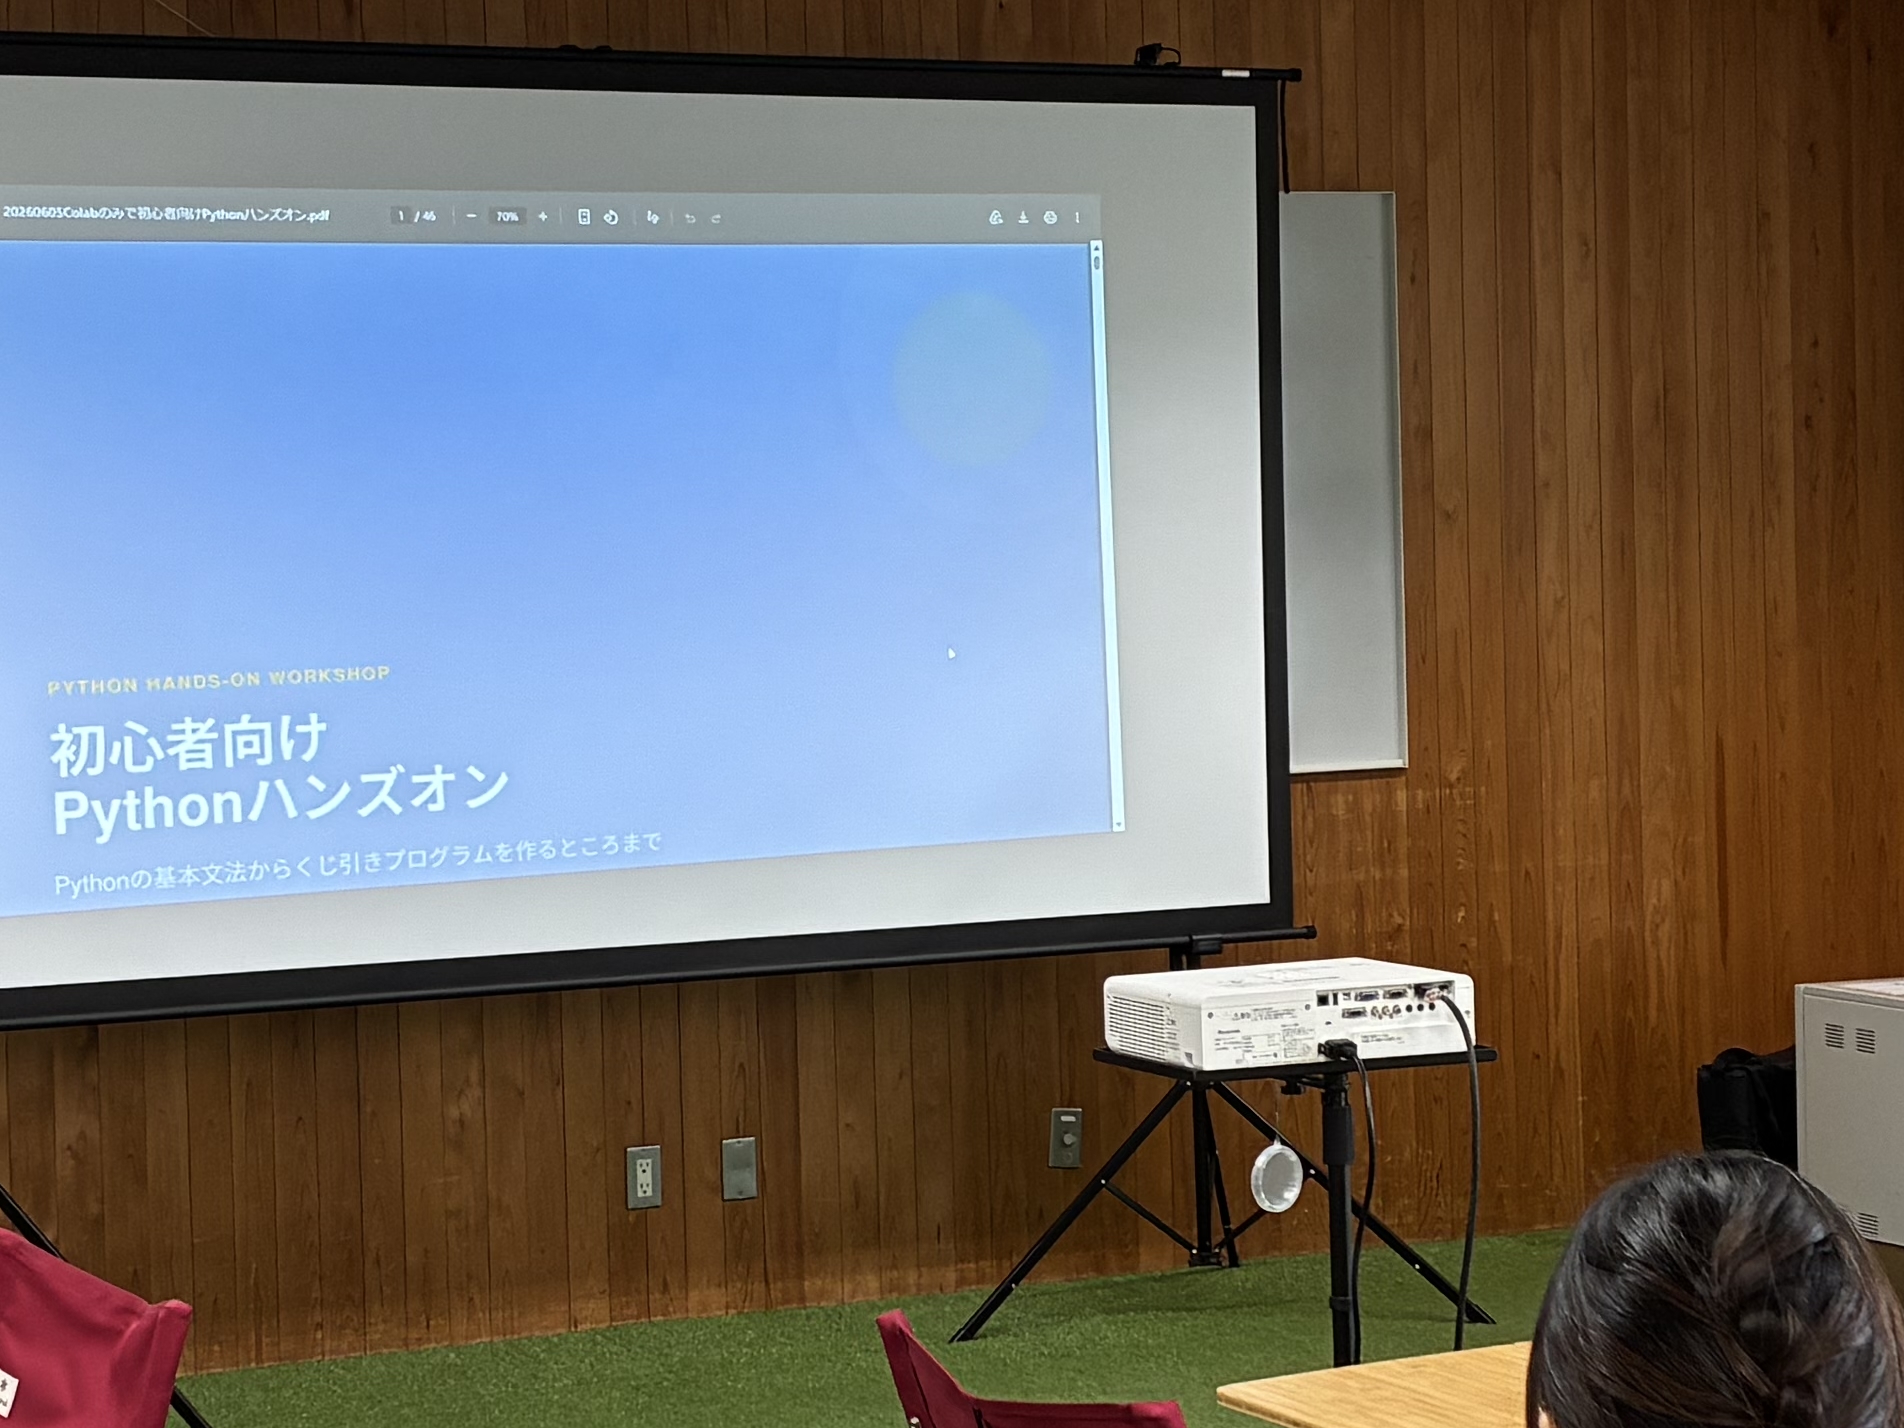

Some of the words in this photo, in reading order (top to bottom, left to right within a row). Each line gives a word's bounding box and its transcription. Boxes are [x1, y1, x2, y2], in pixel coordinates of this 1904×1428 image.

[48, 676, 138, 696] PYTHON
[146, 671, 261, 692] HANDS-ON
[269, 665, 391, 686] WORKSHOP
[49, 713, 328, 779] 初心者向け
[54, 763, 510, 844] Pythonハンズオン
[54, 831, 664, 899] Pythonの基本文法からくじ引きプログラムを作るところまで
